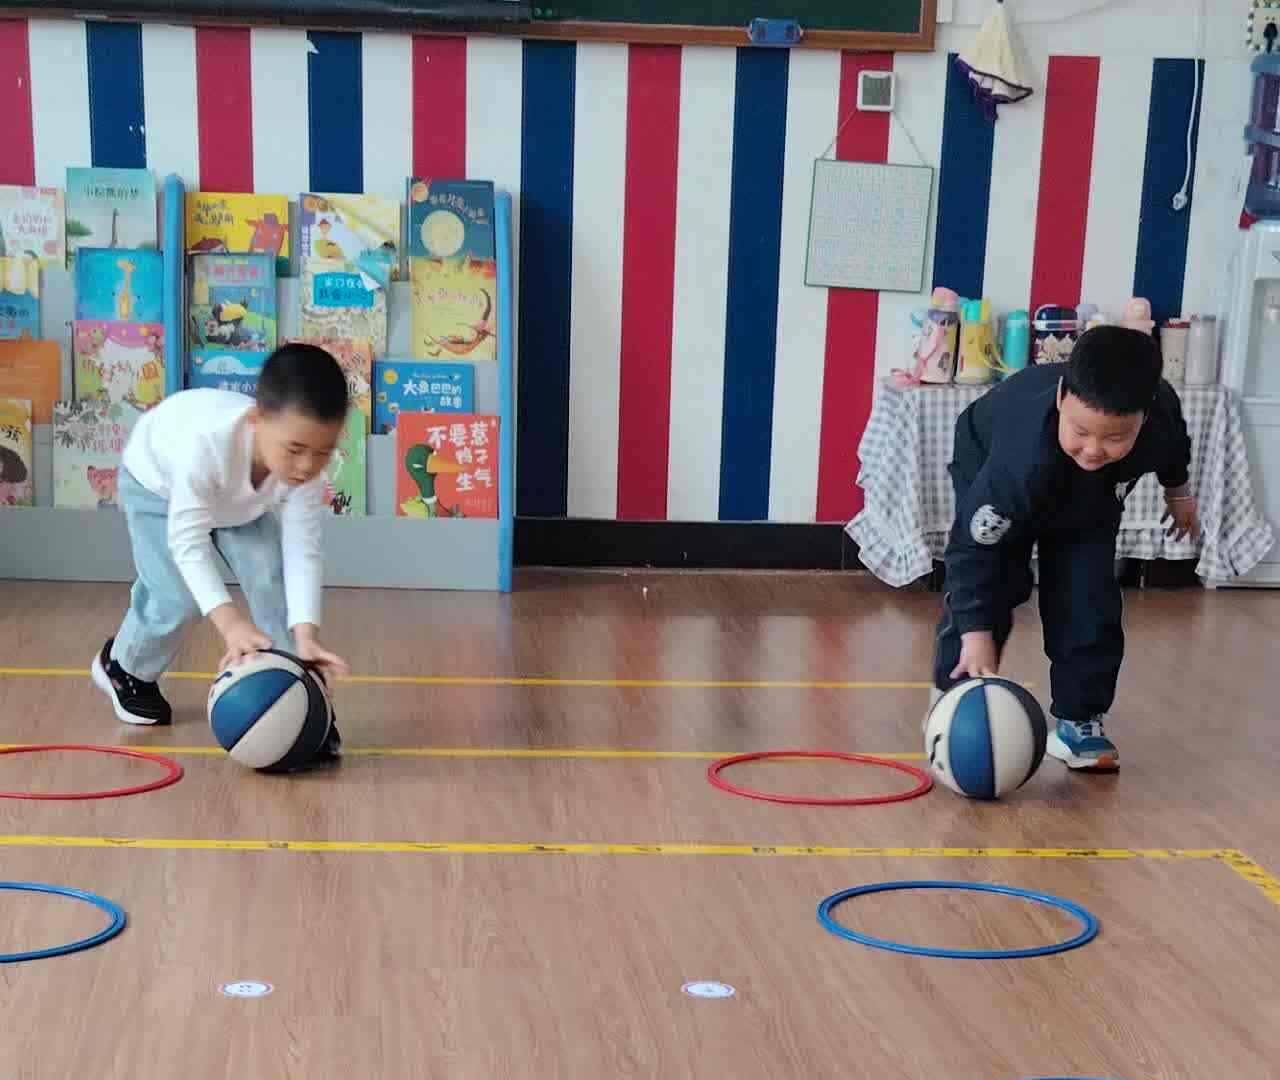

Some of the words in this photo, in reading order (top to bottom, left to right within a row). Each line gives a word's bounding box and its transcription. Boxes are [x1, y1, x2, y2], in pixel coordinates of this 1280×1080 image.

[403, 379, 463, 396] 大象巴巴的
[426, 420, 490, 449] 不要惹
[455, 446, 489, 465] 鸭子
[455, 468, 493, 493] 生气
